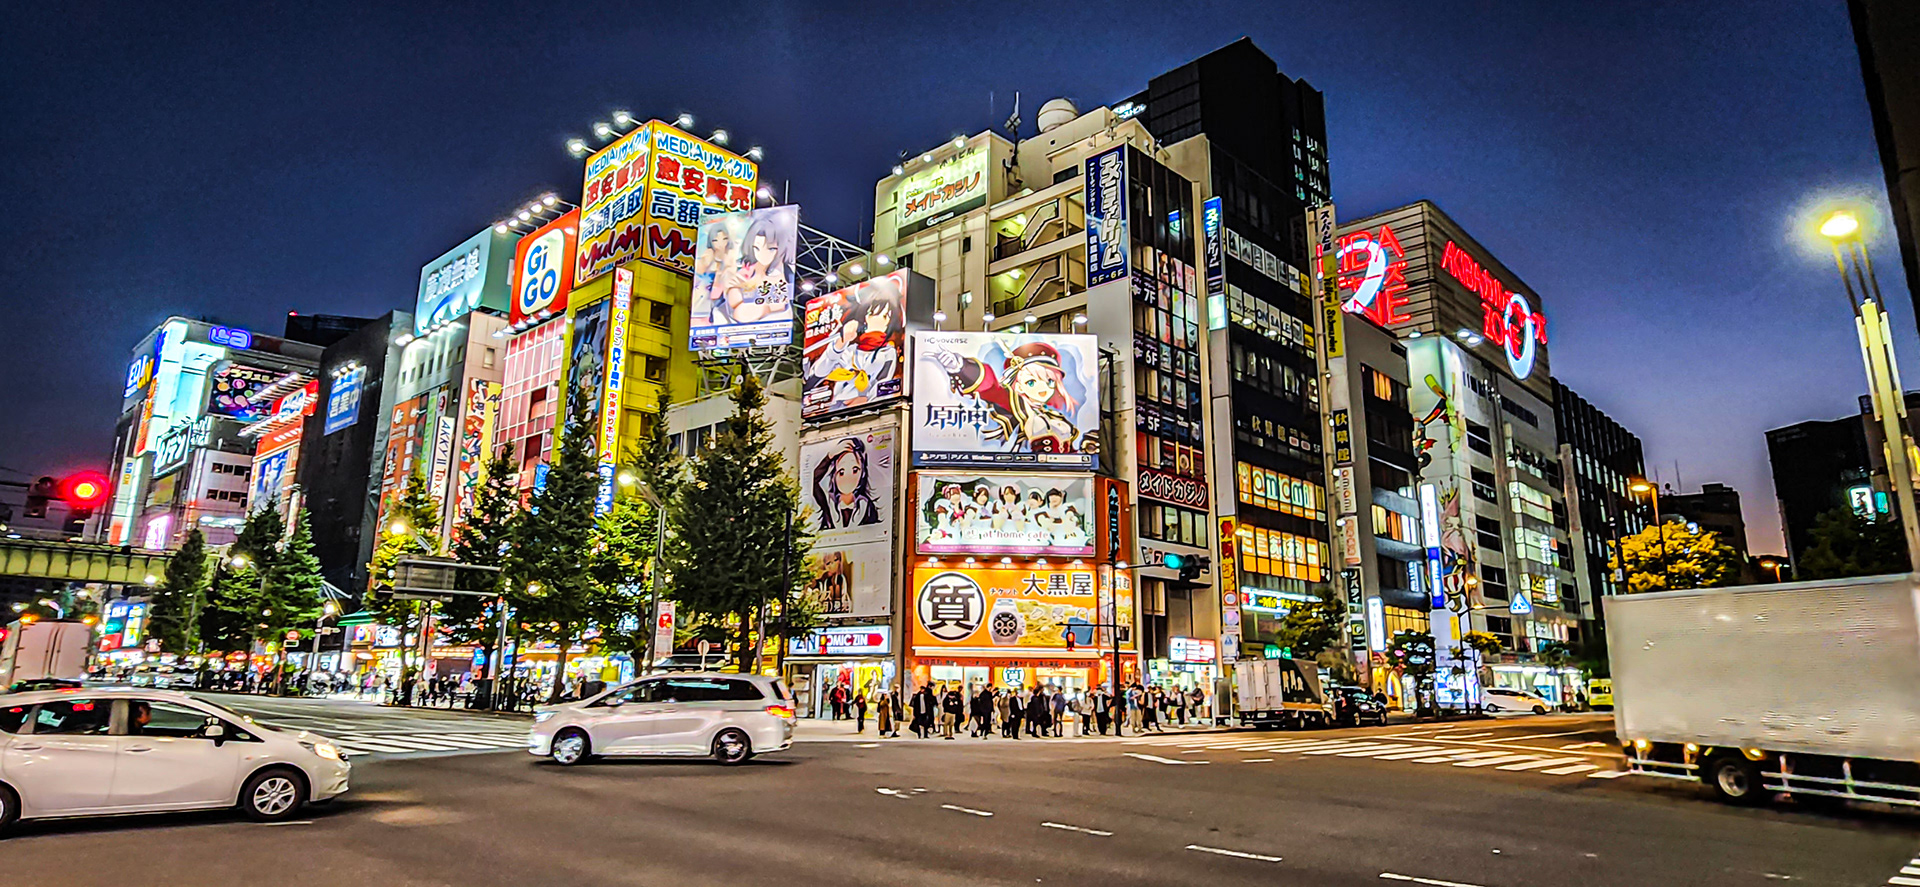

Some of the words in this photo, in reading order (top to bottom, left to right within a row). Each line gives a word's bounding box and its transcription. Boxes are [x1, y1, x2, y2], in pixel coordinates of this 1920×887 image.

[657, 131, 755, 181] MEDIAリサイクル
[586, 153, 648, 208] 激安販売
[656, 155, 753, 211] 激安販売
[582, 186, 644, 241] 高額買取
[524, 269, 556, 307] GO
[1144, 288, 1156, 304] 7F
[1146, 351, 1157, 366] 6F
[923, 396, 988, 439] 原神
[1147, 416, 1160, 431] 5F
[439, 420, 451, 457] AKKY
[1140, 471, 1206, 506] メイドカジノ
[989, 587, 1018, 596] チケット
[1023, 573, 1093, 597] 大黒屋
[927, 583, 978, 632] 質
[826, 634, 852, 646] OMIC
[853, 634, 868, 646] ZIN
